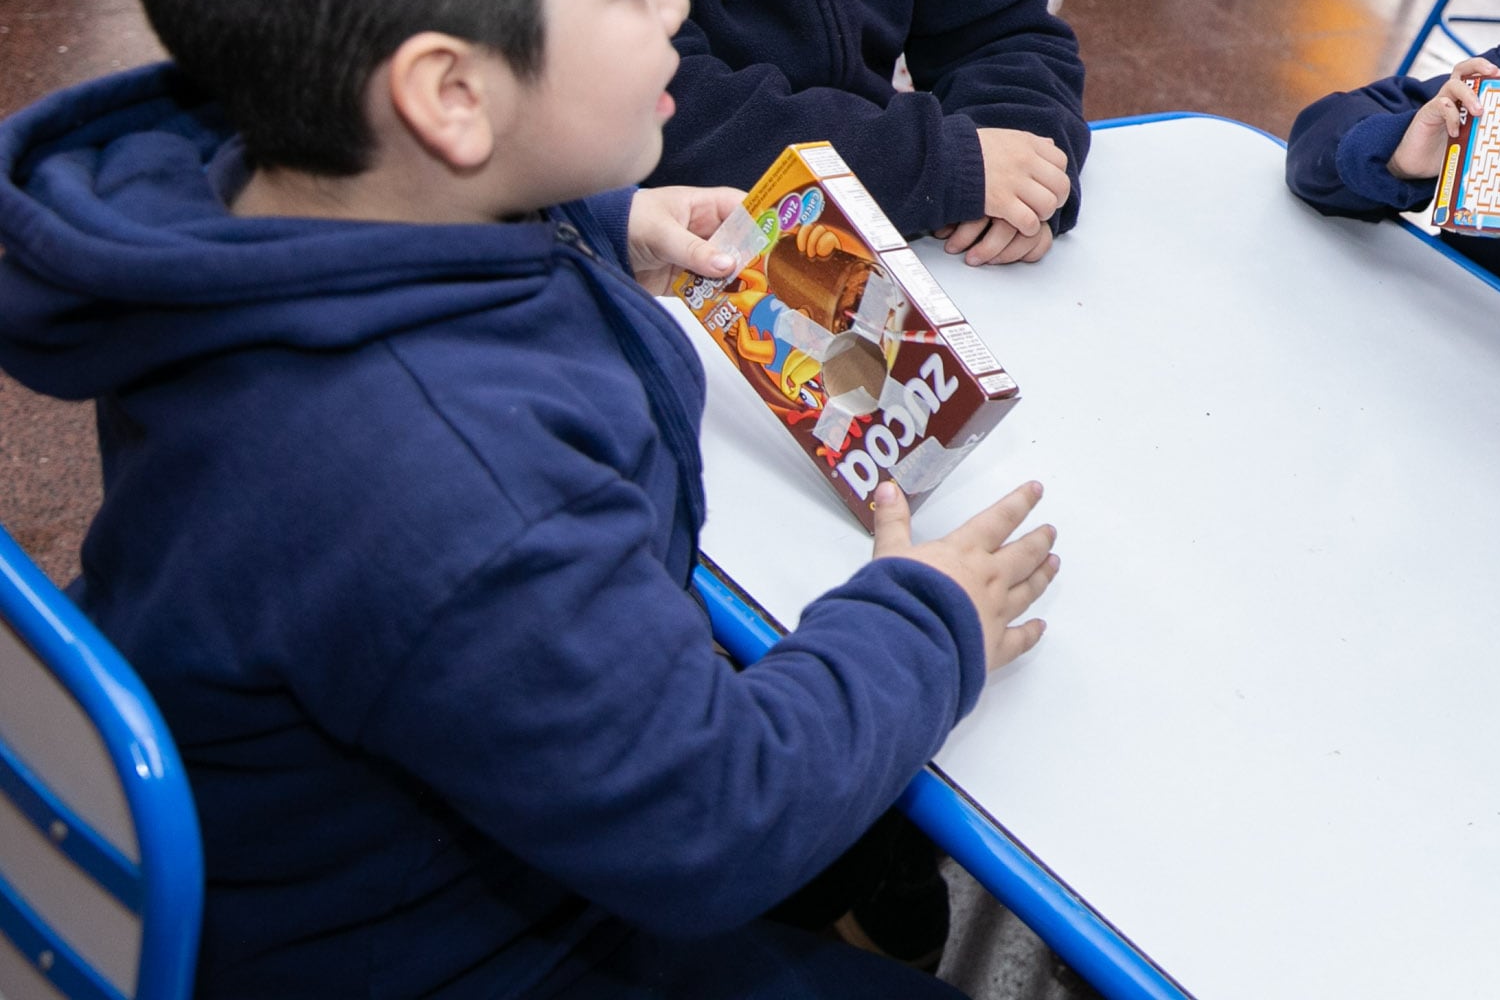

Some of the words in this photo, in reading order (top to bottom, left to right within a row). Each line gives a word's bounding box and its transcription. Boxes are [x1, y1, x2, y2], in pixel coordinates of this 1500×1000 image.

[707, 320, 717, 331] g
[713, 301, 738, 327] 180
[836, 352, 960, 501] zucoa
